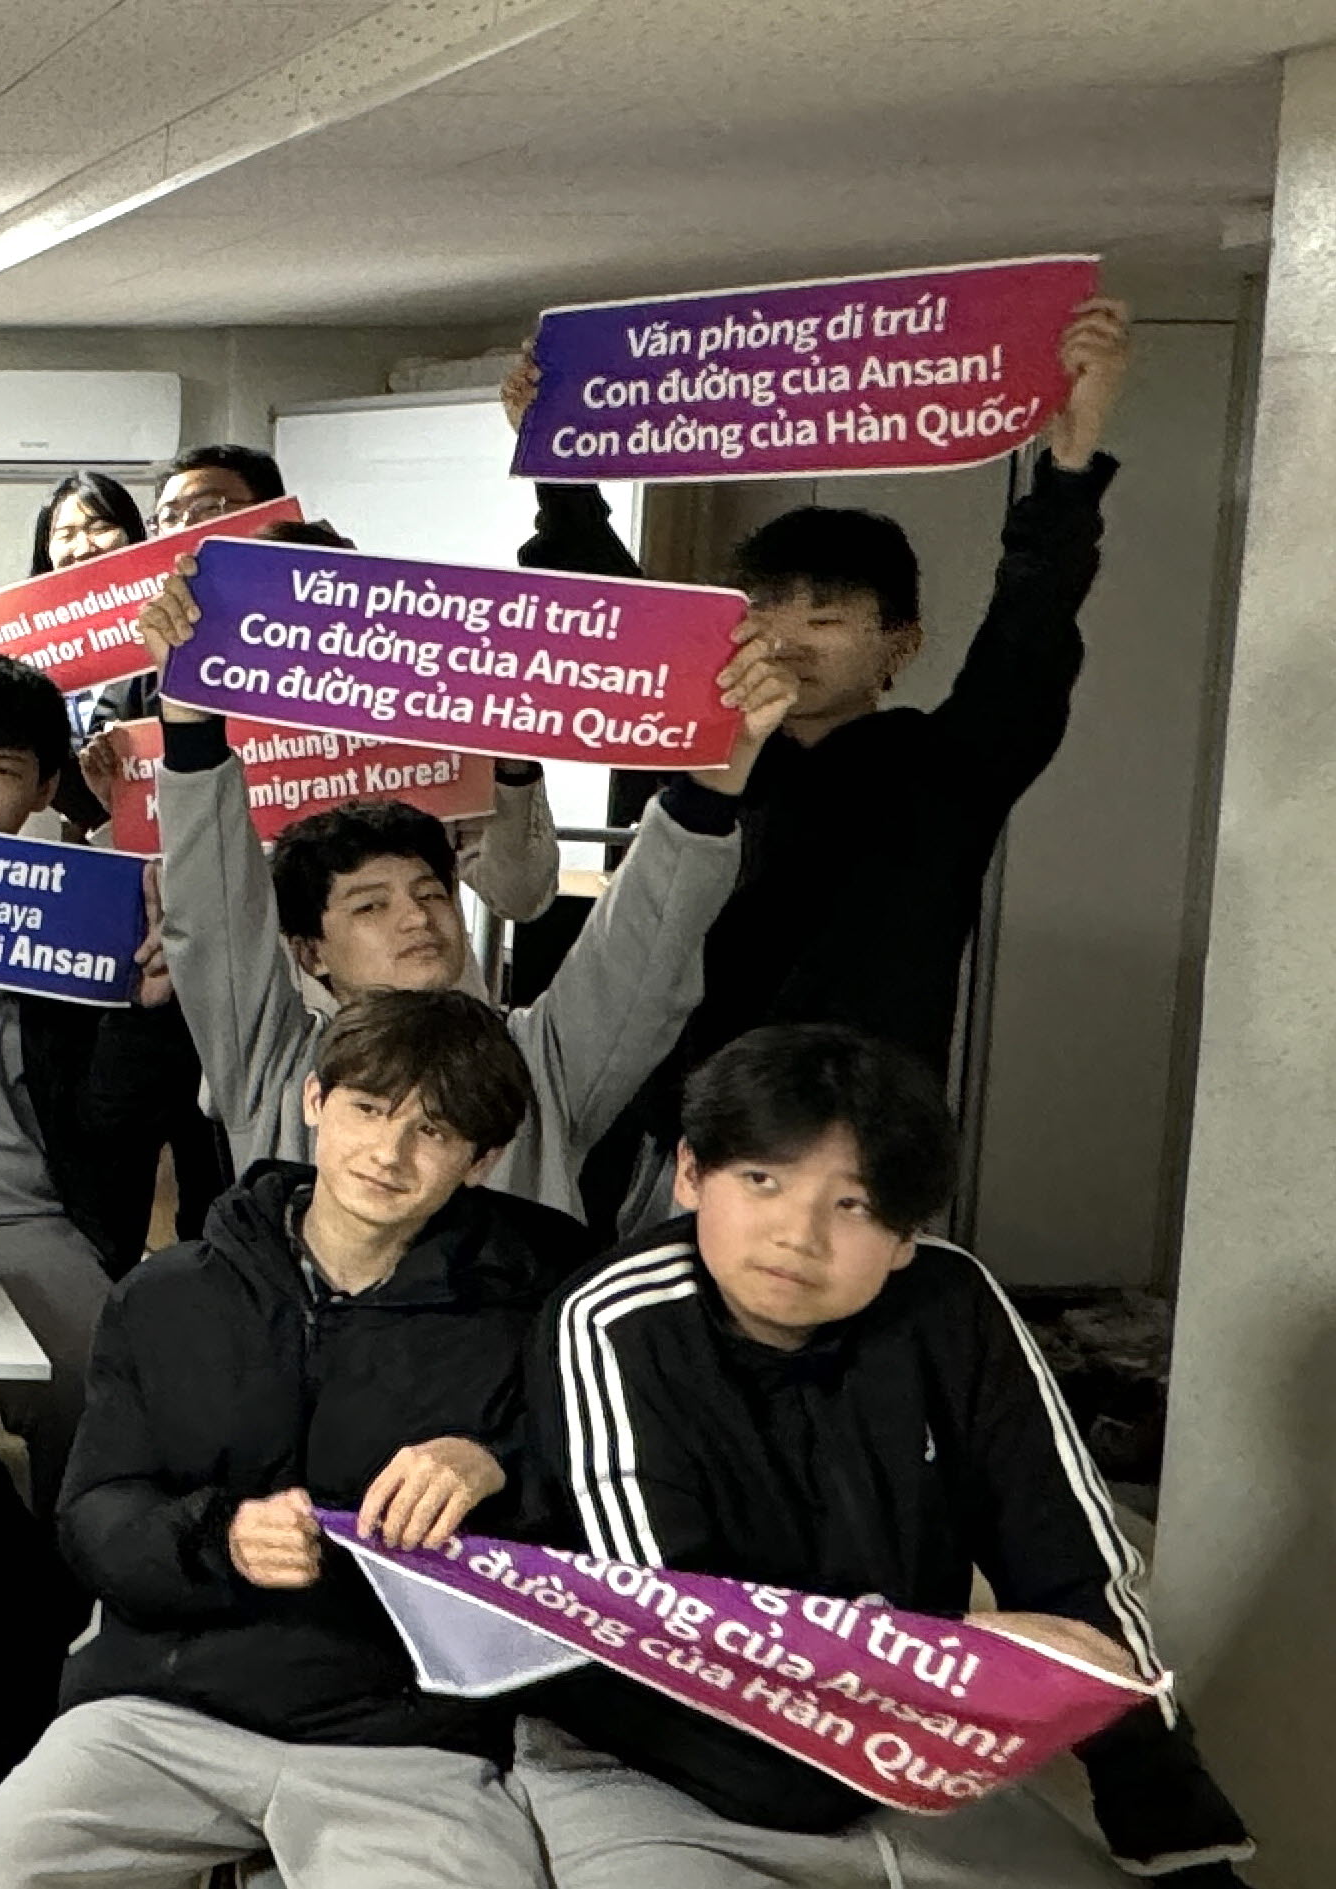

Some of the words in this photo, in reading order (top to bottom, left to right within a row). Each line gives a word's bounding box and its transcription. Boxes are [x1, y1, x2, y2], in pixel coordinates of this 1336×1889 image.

[628, 320, 691, 358] Văn
[698, 310, 821, 360] phòng
[827, 308, 863, 342] di
[871, 293, 947, 336] trú!
[584, 374, 649, 409] Con
[657, 360, 776, 405] đường
[782, 355, 850, 397] của
[858, 344, 1004, 390] Ansan!
[552, 424, 620, 458] Con
[627, 413, 744, 460] đường
[750, 405, 818, 448] của
[826, 402, 907, 443] Hàn
[291, 568, 360, 608] Văn
[366, 580, 490, 632] phòng
[498, 592, 538, 632] di
[545, 600, 621, 641] trú!
[240, 612, 311, 653] Con
[318, 621, 440, 677] đường
[448, 634, 519, 680] của
[525, 649, 668, 699] Ansan!
[200, 655, 271, 694] Con
[277, 665, 397, 720] đường
[404, 677, 475, 724] của
[482, 687, 564, 738] Hàn
[571, 703, 699, 752] Quốc!
[365, 752, 462, 793] Korea!
[8, 935, 117, 984] Ansan
[467, 1547, 637, 1649] đường
[638, 1637, 737, 1691] của
[740, 1674, 857, 1747] Hàn
[866, 1613, 981, 1699] trú!
[713, 1619, 817, 1682] của
[816, 1670, 1027, 1764] Ansan!
